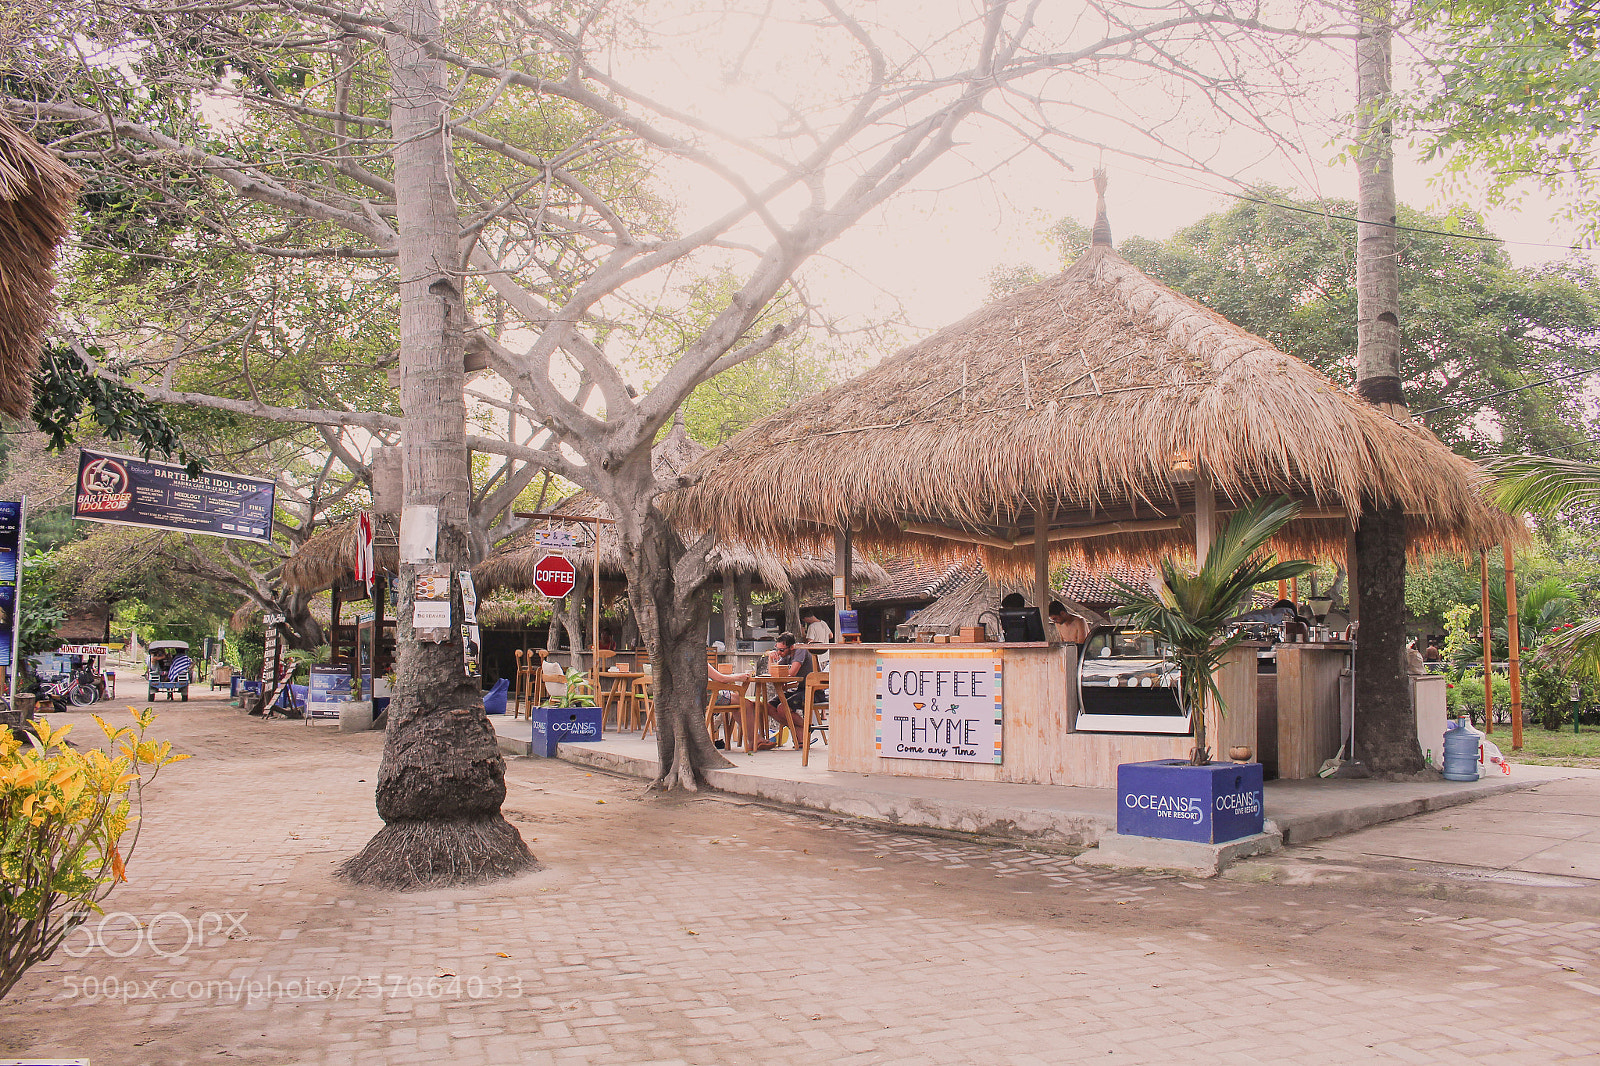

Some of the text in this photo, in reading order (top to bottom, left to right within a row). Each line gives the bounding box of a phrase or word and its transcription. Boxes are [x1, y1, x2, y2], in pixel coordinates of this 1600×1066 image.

[212, 478, 234, 489] IDOL
[236, 482, 256, 492] 2015
[78, 493, 132, 503] BARTENDER
[174, 491, 200, 500] MIXOLOGY
[80, 500, 128, 511] IDOL 2015
[536, 570, 573, 583] COFFEE
[61, 645, 106, 654] MONEY CHANGER
[888, 670, 987, 697] COFFEE
[931, 698, 939, 712] &
[894, 716, 980, 745] THYME
[896, 744, 976, 757] Come any Time
[1174, 811, 1198, 820] RESORT
[1235, 805, 1258, 815] DIVE RESORT
